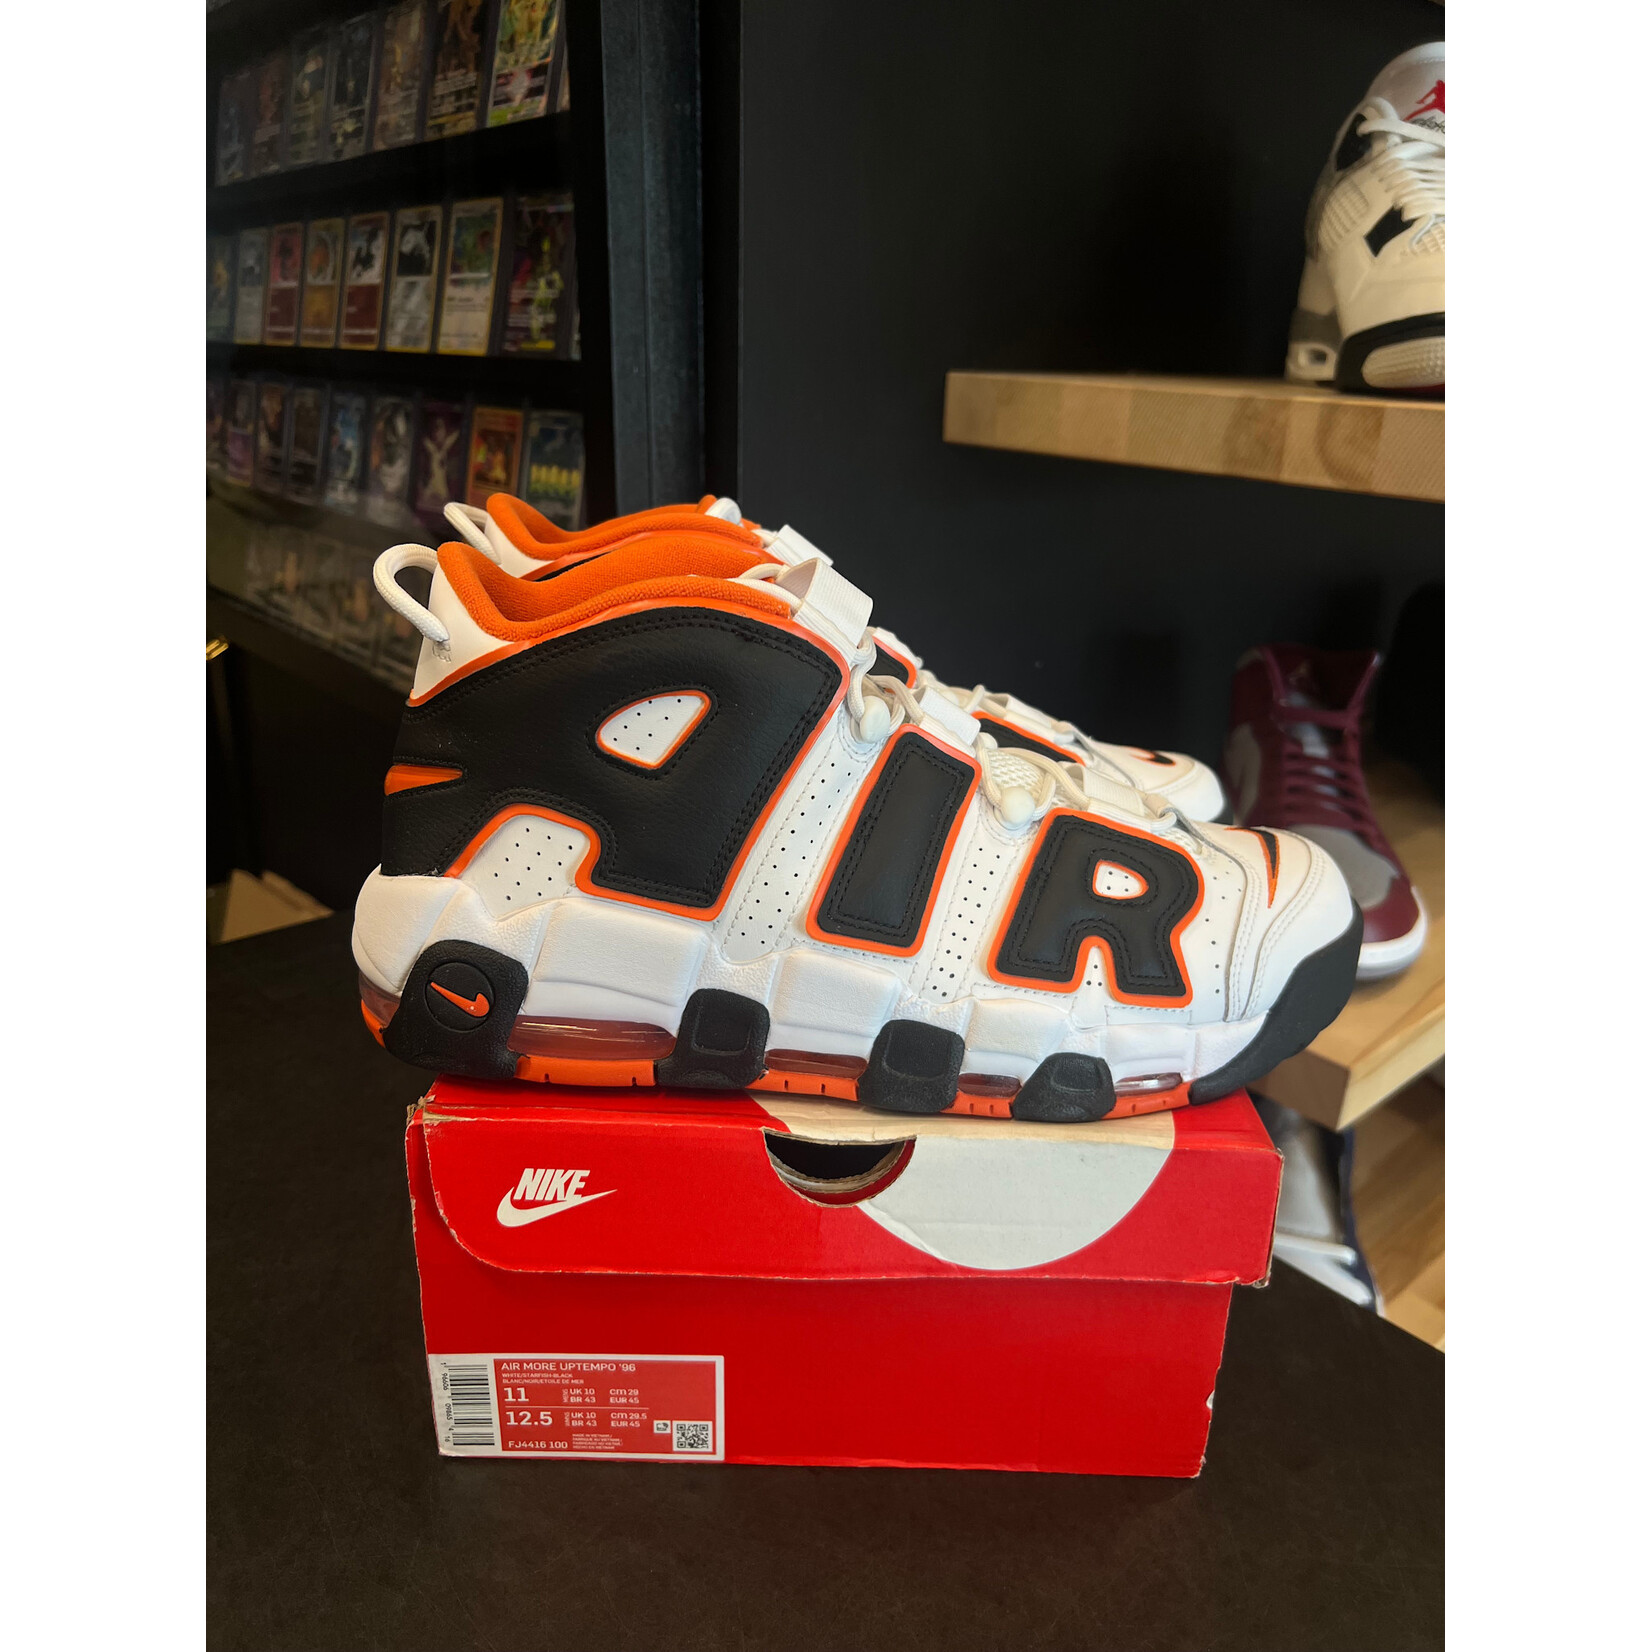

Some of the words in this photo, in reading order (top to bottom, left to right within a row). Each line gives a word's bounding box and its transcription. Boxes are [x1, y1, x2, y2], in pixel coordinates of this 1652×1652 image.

[513, 1168, 590, 1201] NIKE
[501, 1362, 521, 1371] AIR
[523, 1362, 557, 1371] MORE
[560, 1362, 616, 1372] UPTEMPO
[619, 1363, 636, 1372] '96
[504, 1387, 529, 1402] 11
[505, 1411, 553, 1426] 12.5
[629, 1412, 647, 1420] 29.5
[508, 1440, 547, 1449] FJ4416
[549, 1441, 568, 1449] 100
